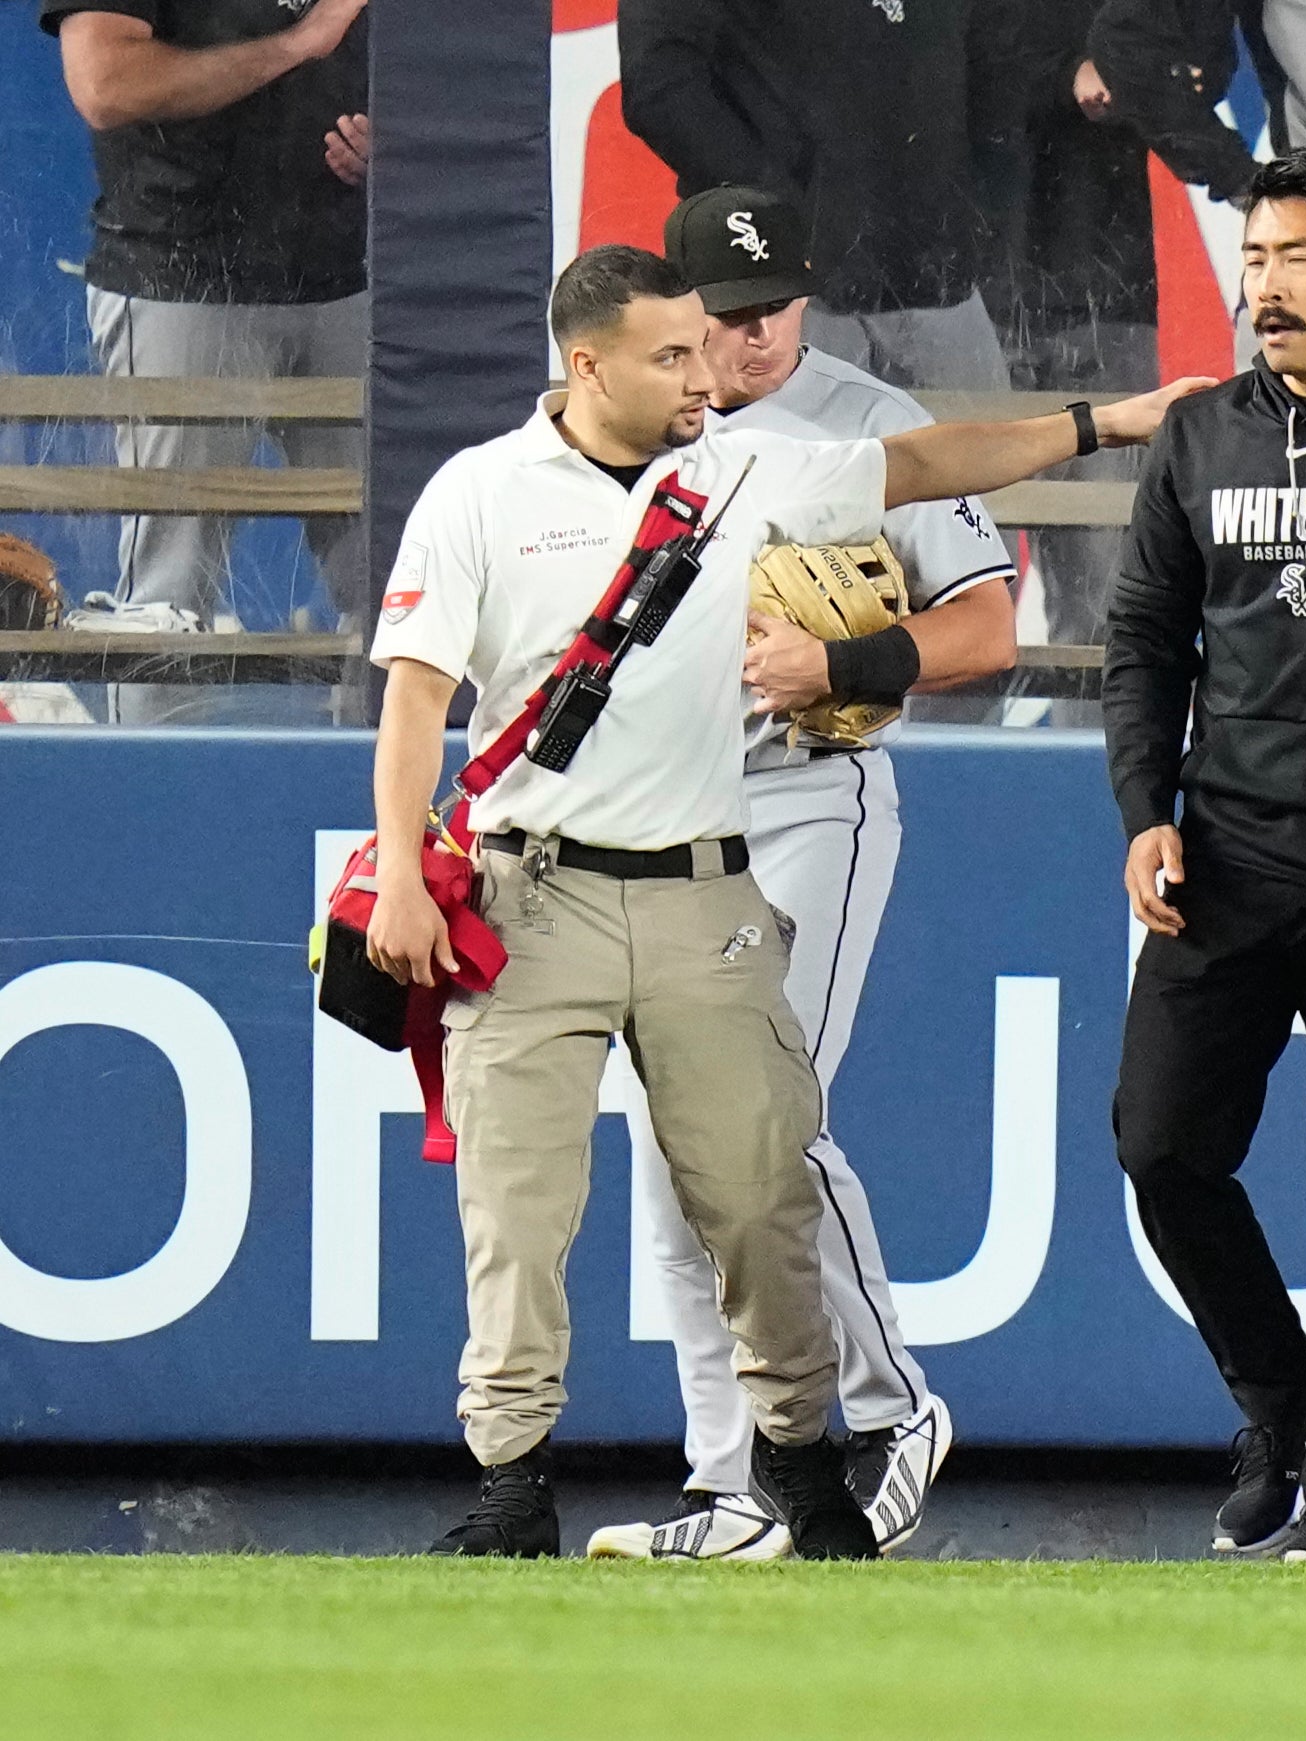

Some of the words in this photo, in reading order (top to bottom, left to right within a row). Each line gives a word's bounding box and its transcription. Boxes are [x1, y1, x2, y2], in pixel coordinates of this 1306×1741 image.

[727, 211, 770, 261] Sox
[952, 496, 992, 541] ox
[520, 544, 542, 556] EMS
[546, 536, 609, 552] Supervisor
